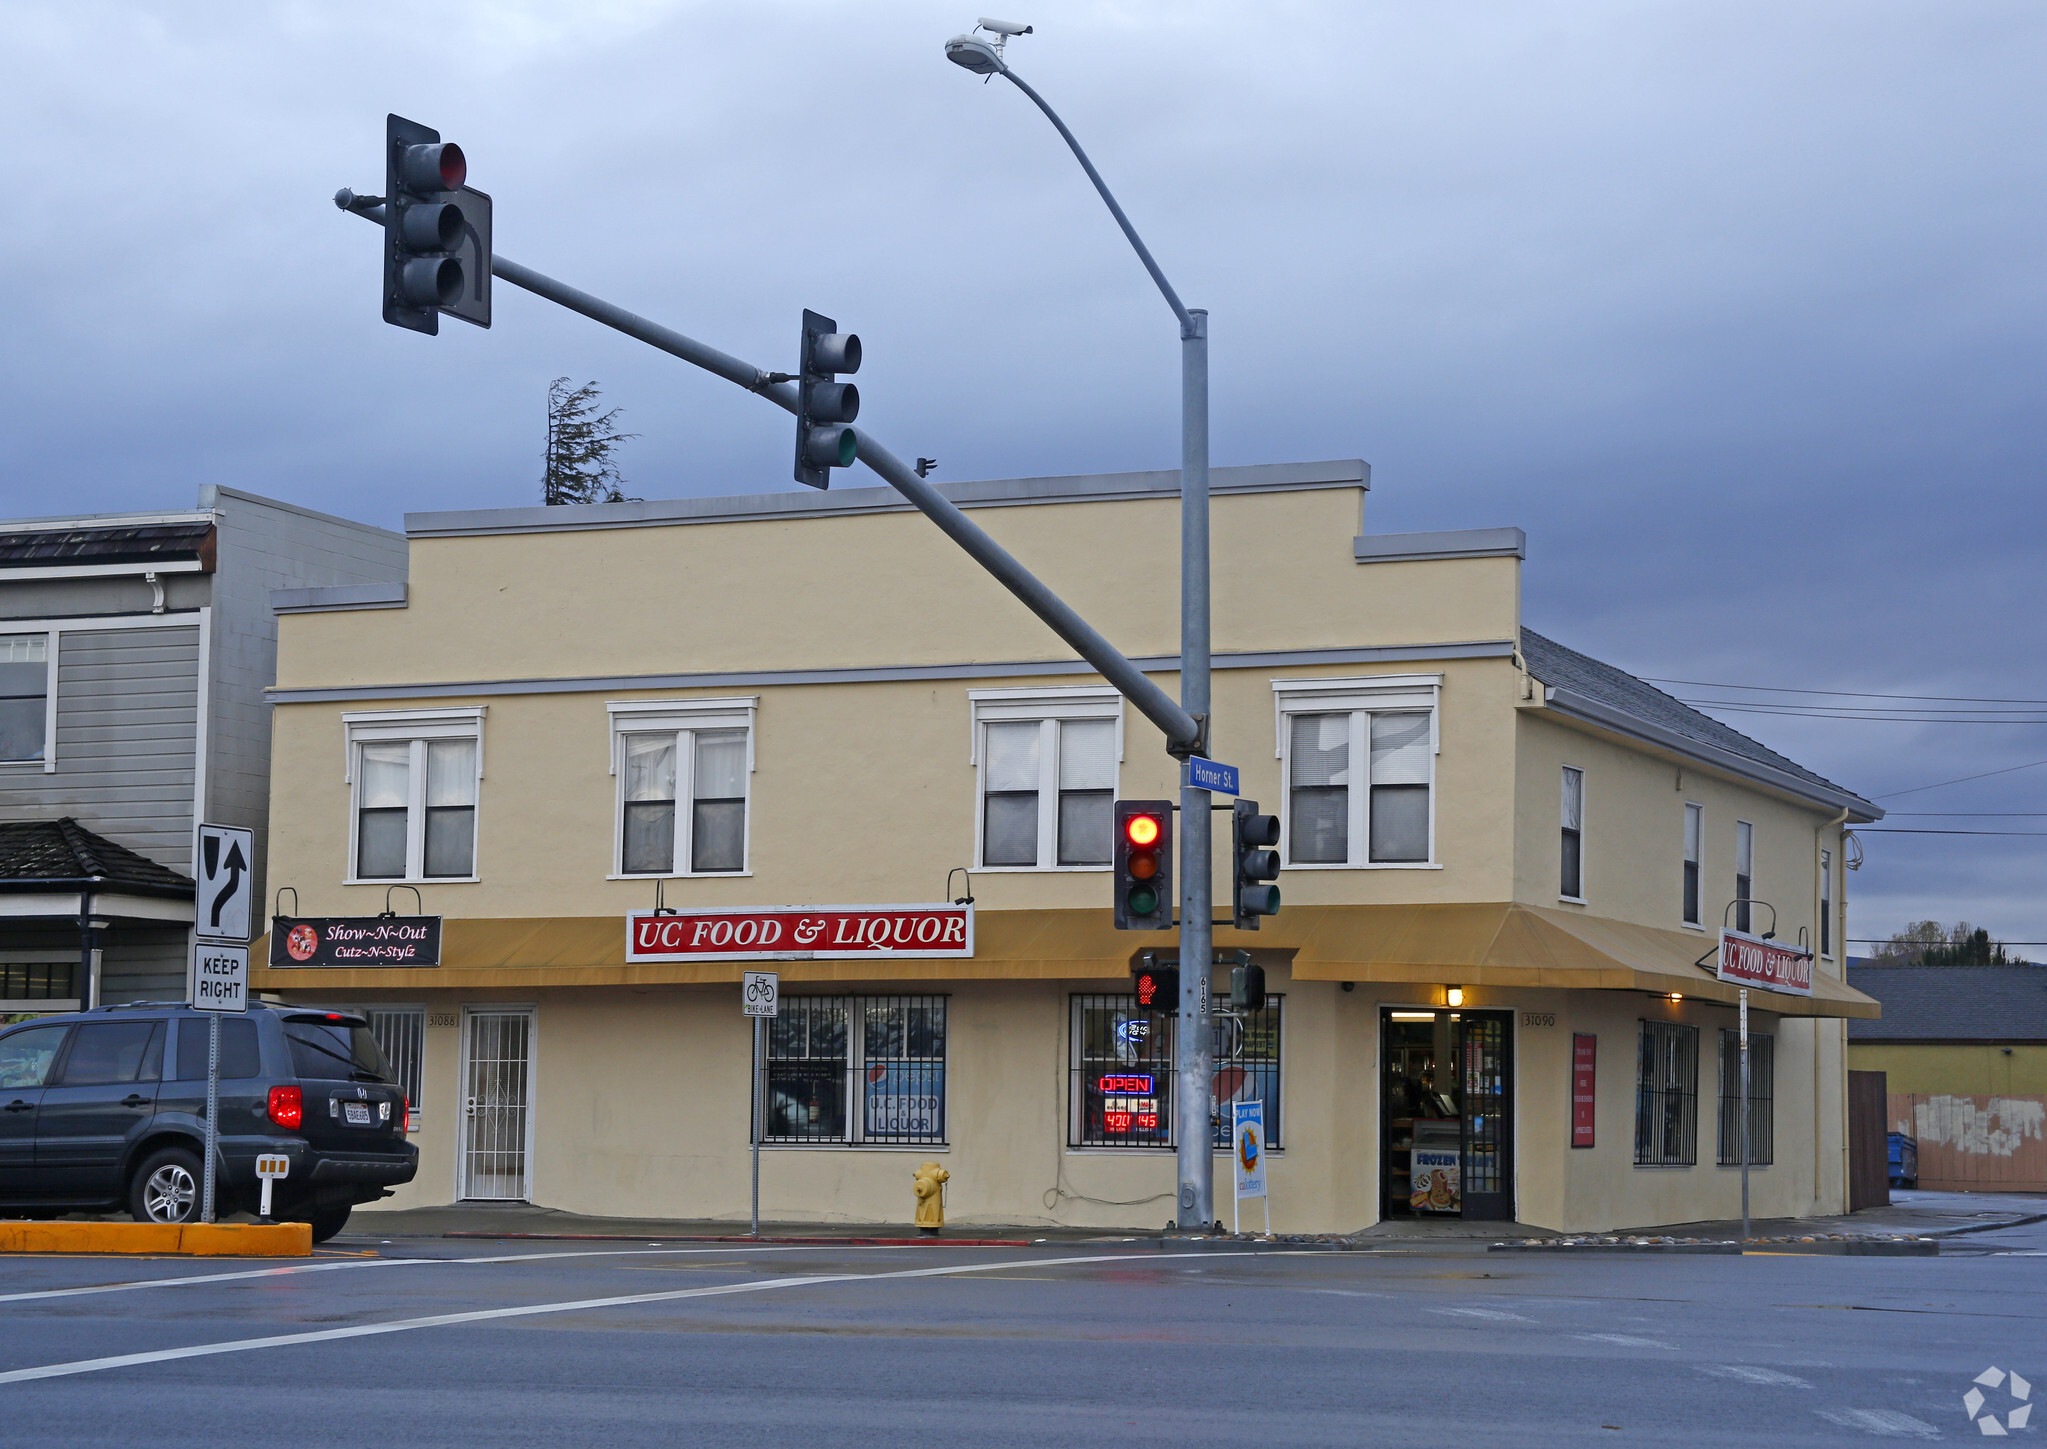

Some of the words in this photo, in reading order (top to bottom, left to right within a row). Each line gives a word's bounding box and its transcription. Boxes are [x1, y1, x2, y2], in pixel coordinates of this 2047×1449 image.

[1195, 764, 1221, 786] Horner
[1223, 770, 1234, 788] St.
[638, 921, 683, 948] UC
[689, 919, 783, 947] FOOD
[793, 918, 826, 944] &
[832, 916, 966, 951] LIQUOR
[203, 957, 239, 975] KEEP
[1723, 942, 1737, 968] UC
[1737, 945, 1764, 974] FOOD
[1765, 952, 1775, 976] &
[1776, 954, 1809, 987] LIQUOR
[200, 980, 241, 999] RIGHT
[747, 1004, 759, 1013] BIKE
[761, 1005, 774, 1014] LANE
[429, 1015, 456, 1026] 31088
[1525, 1015, 1555, 1026] 31090
[1099, 1077, 1149, 1092] OPEN
[870, 1097, 896, 1110] U.C.
[899, 1097, 938, 1110] FOOD
[1236, 1108, 1248, 1118] PLAY
[1248, 1107, 1261, 1118] NOW
[878, 1117, 930, 1131] LQUOR
[1416, 1153, 1457, 1166] FROZEN
